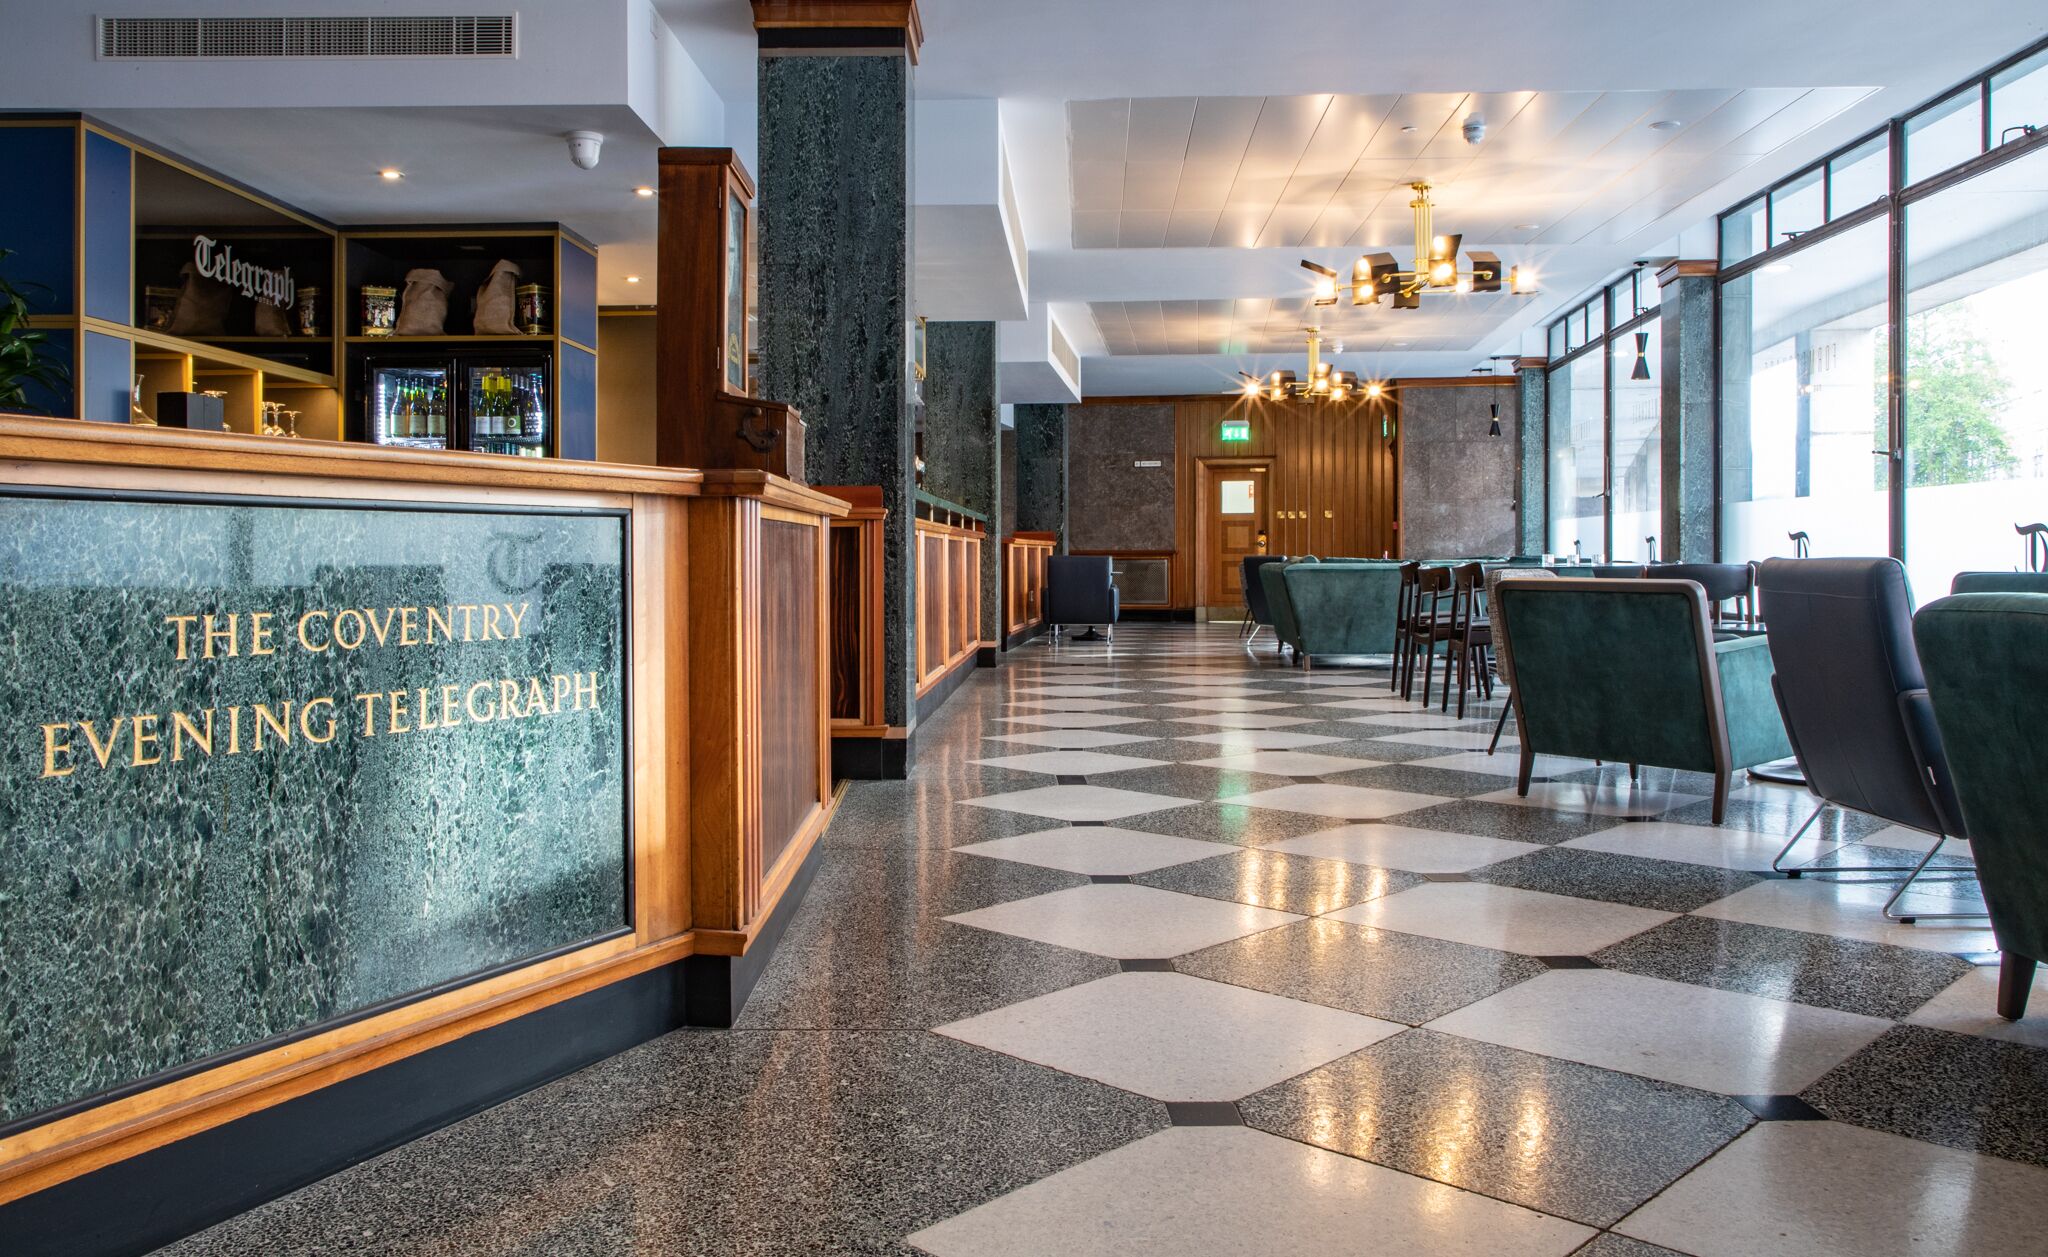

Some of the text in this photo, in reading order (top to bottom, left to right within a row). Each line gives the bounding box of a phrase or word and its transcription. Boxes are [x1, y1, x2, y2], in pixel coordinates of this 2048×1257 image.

[193, 235, 294, 310] Telegraph
[165, 602, 529, 661] THE COVENTRY
[39, 671, 600, 779] EVENING TELEGRAPH
